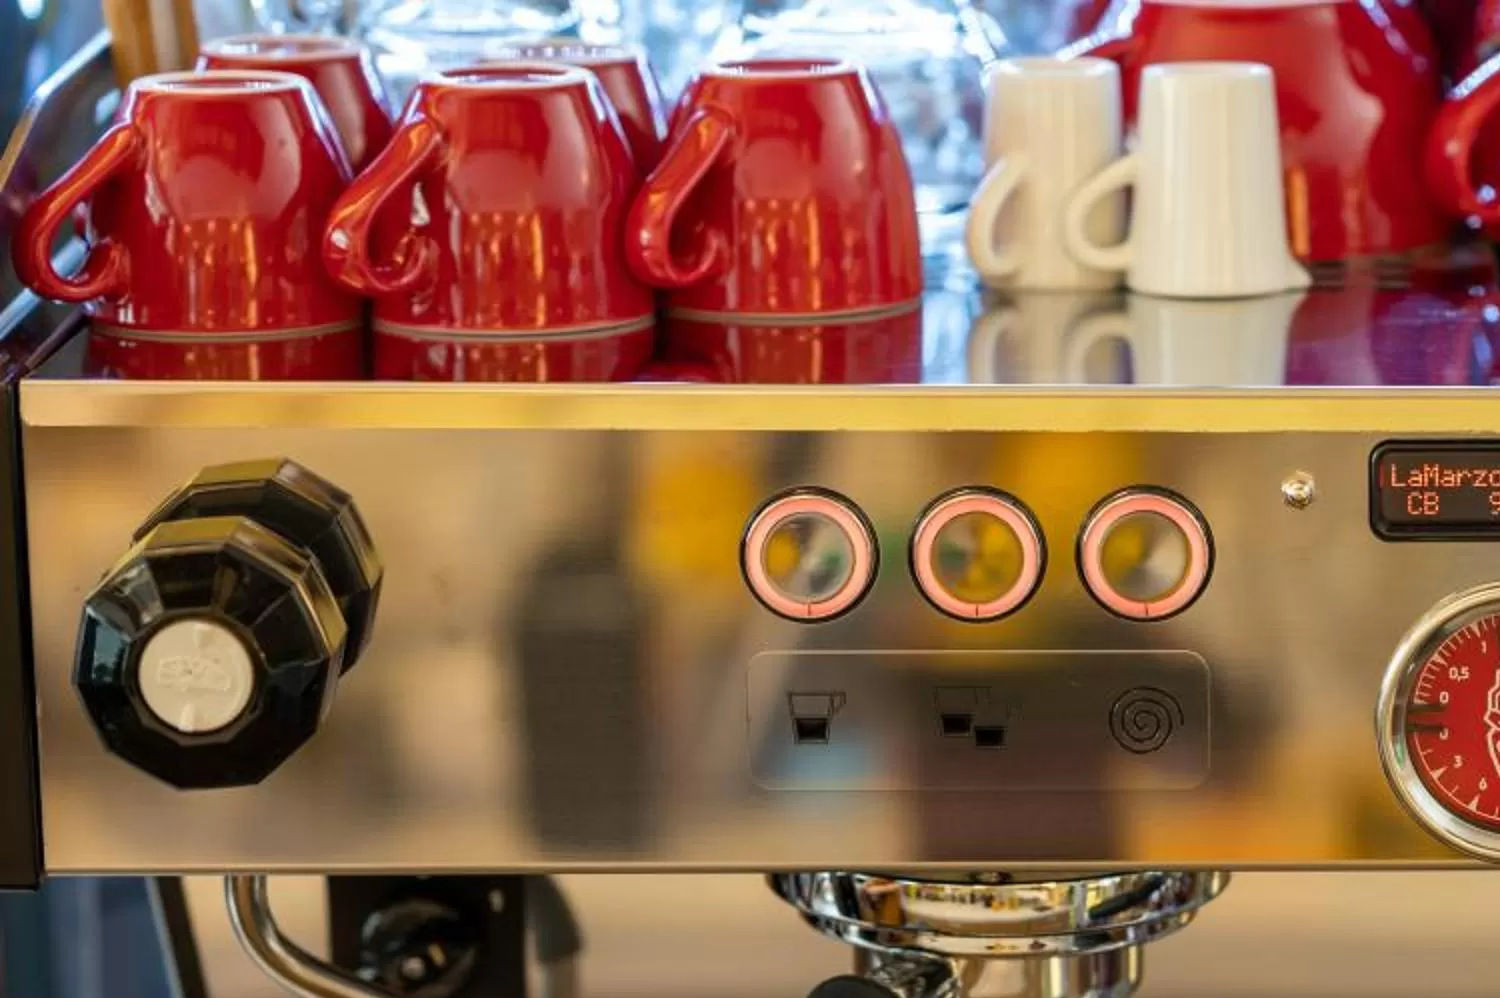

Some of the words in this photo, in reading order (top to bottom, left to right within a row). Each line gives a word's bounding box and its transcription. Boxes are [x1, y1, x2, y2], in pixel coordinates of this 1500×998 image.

[1406, 492, 1440, 516] CB
[1481, 641, 1487, 654] 1
[1439, 691, 1449, 705] 0
[1453, 755, 1463, 769] 3
[1479, 777, 1487, 791] 6
